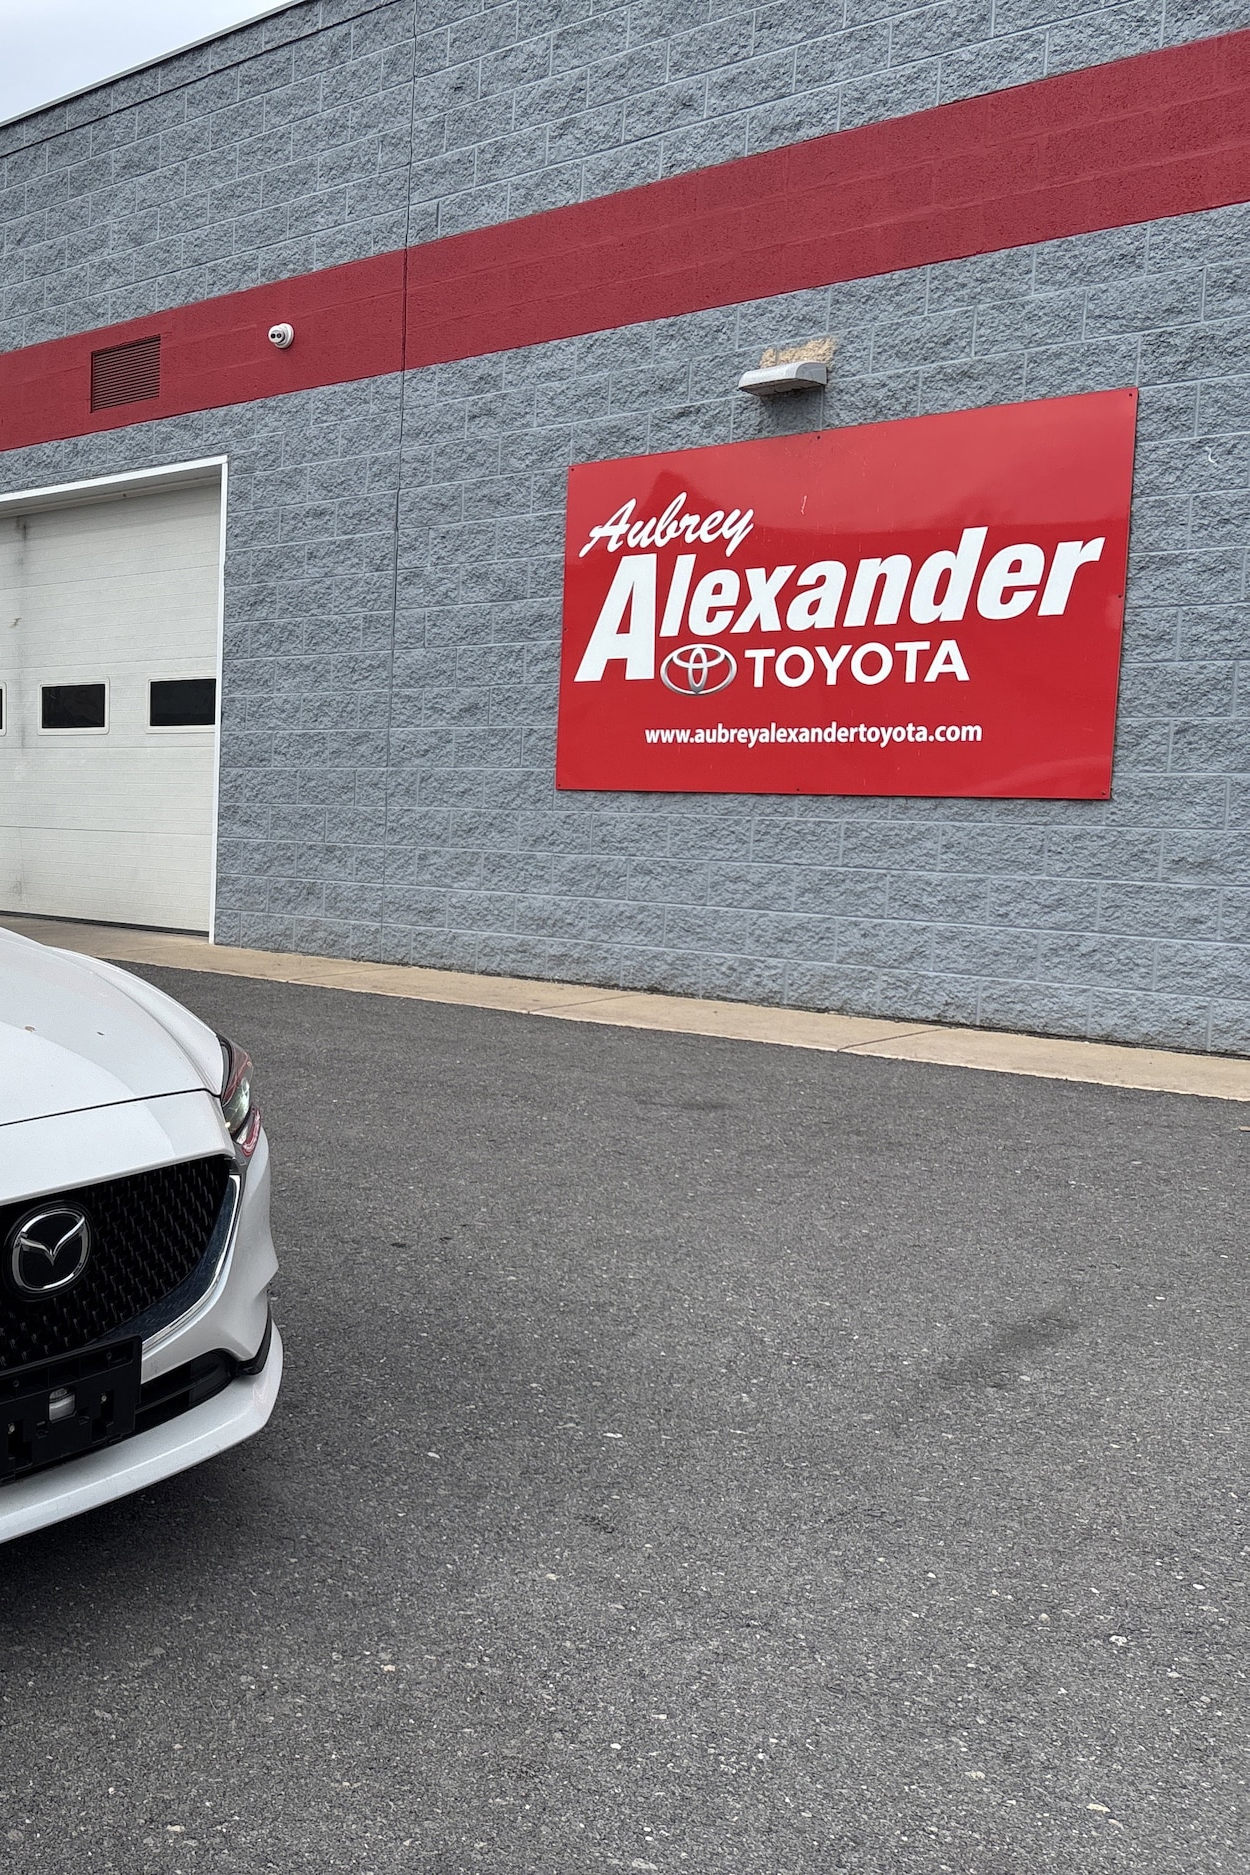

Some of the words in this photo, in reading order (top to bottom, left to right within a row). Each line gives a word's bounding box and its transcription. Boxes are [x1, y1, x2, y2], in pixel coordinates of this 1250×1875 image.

[578, 491, 754, 558] Aubrey
[573, 526, 1106, 682] Alexander
[744, 639, 970, 688] TOYOTA
[644, 721, 983, 749] www.aubreyalexandertoyota.com
